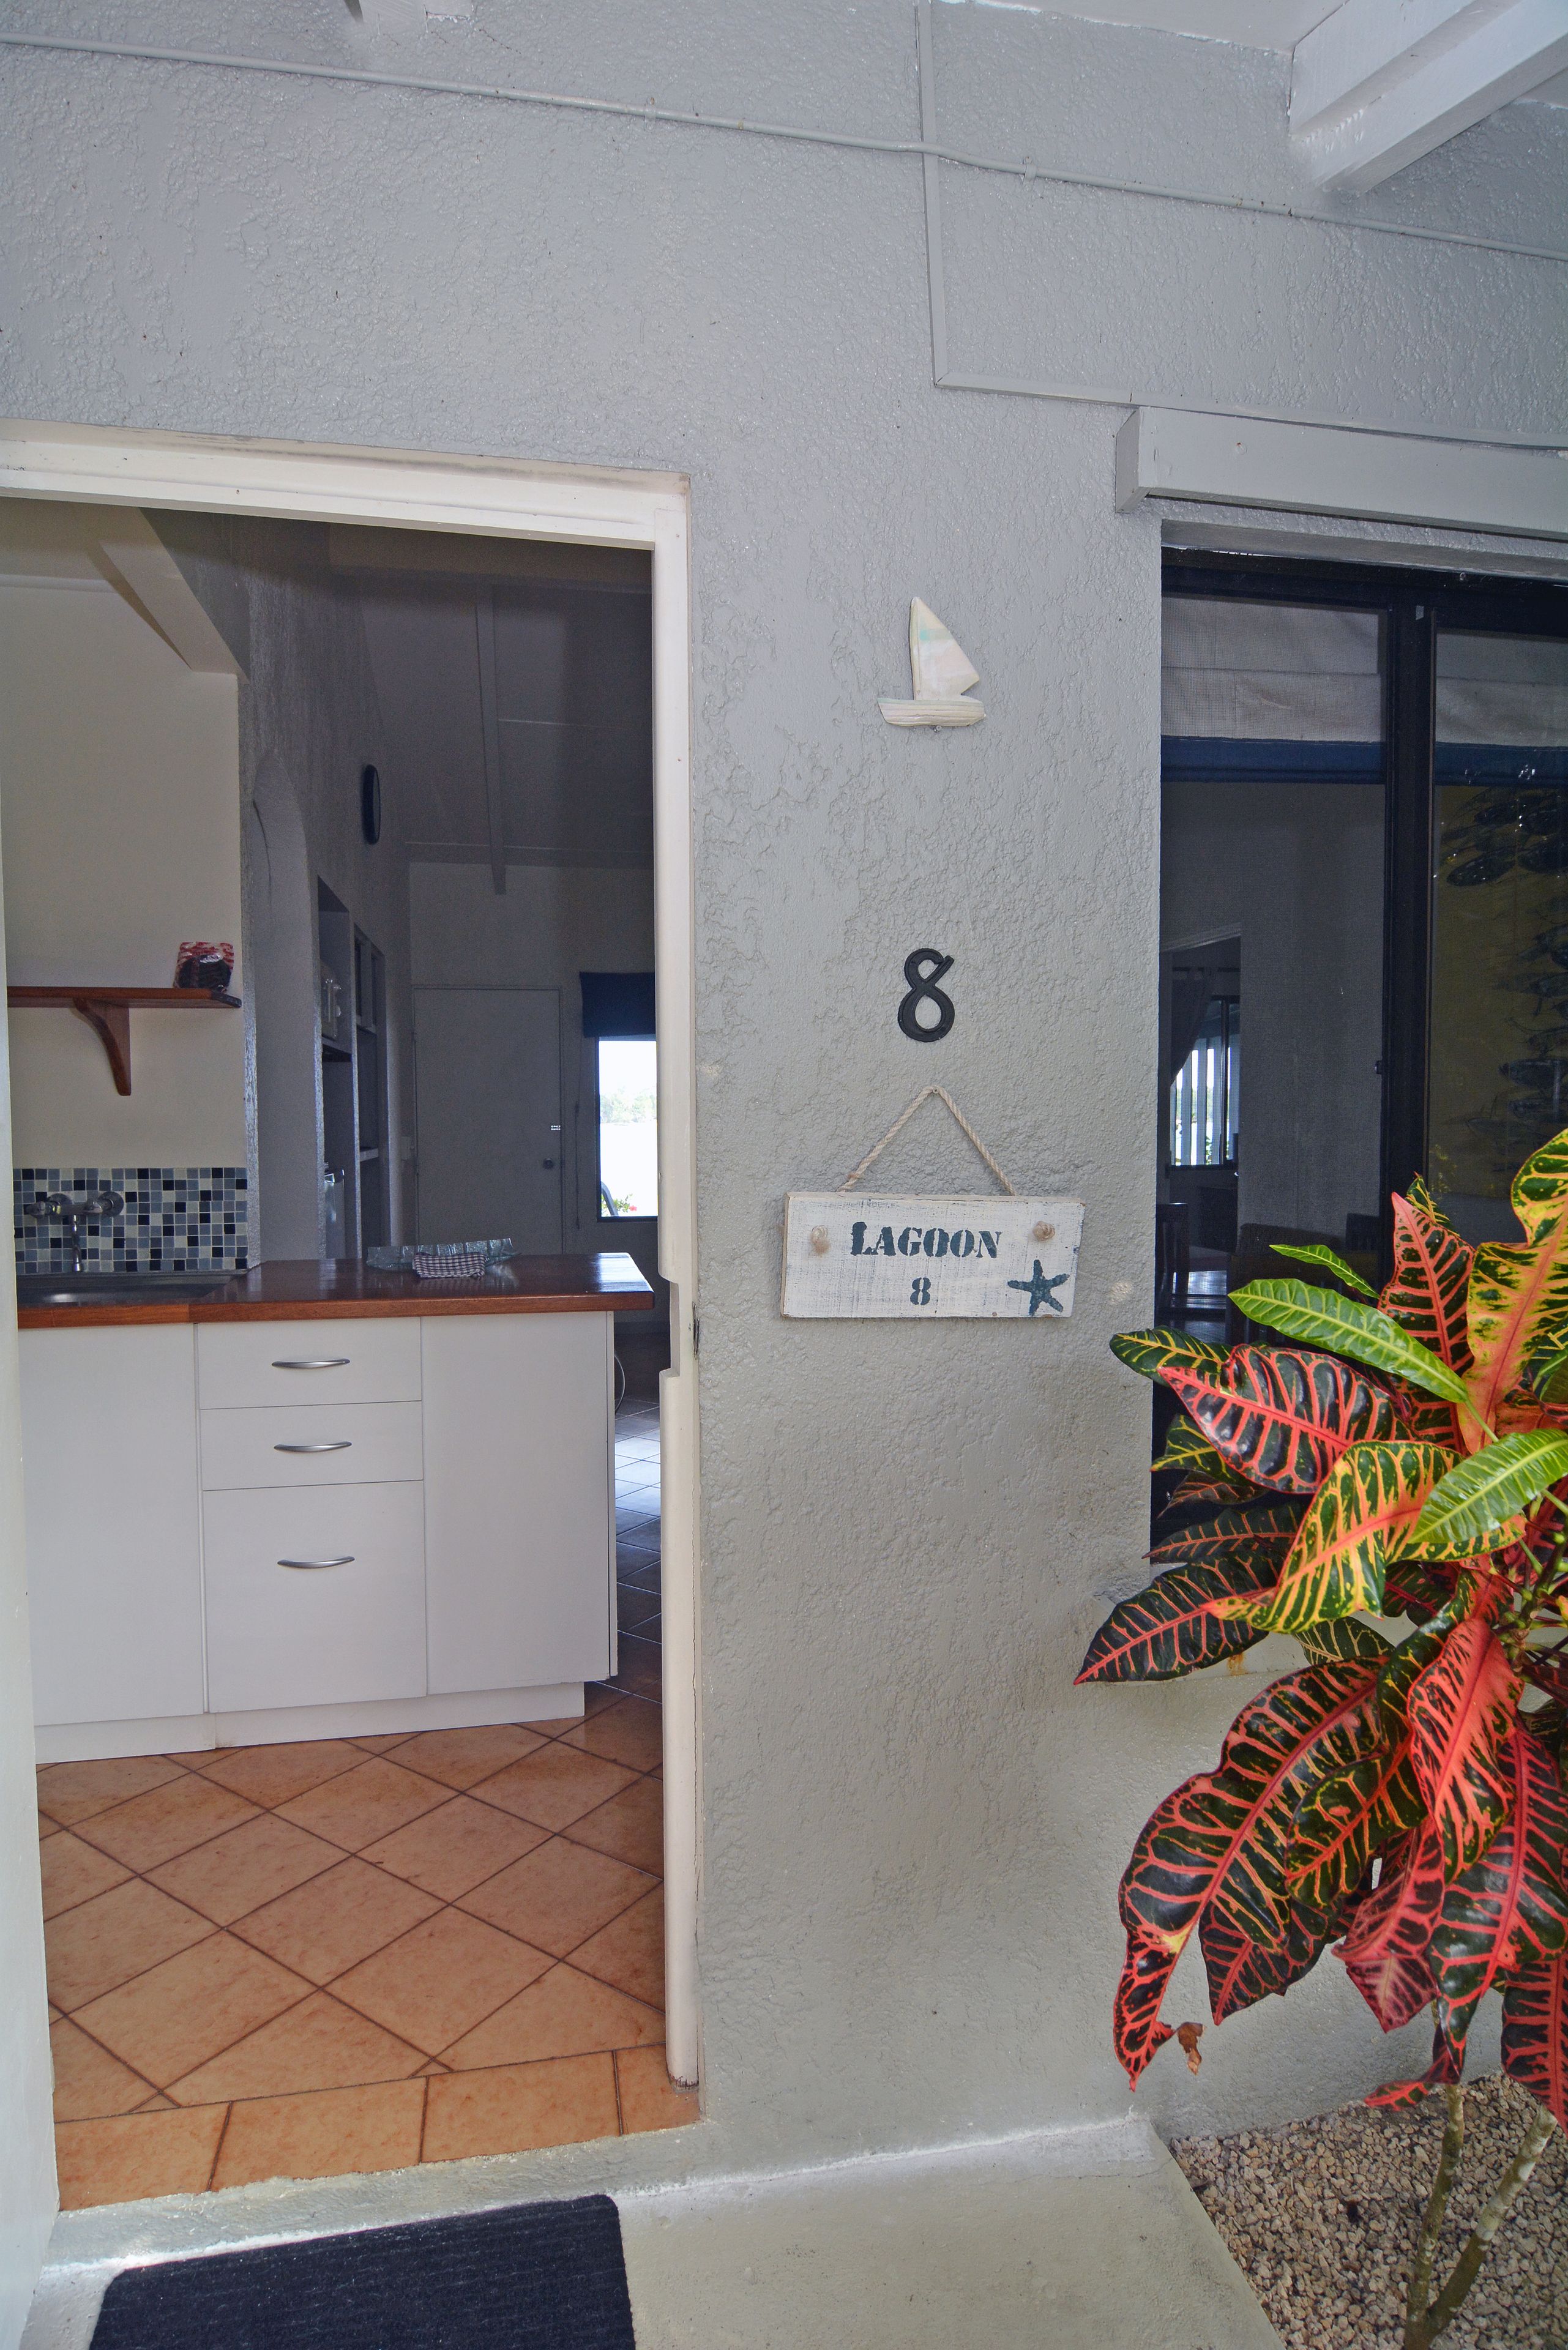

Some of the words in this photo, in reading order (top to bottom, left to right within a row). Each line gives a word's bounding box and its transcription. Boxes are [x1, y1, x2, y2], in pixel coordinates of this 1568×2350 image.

[898, 948, 954, 1042] 8
[850, 1222, 1002, 1258] LAGOON
[909, 1277, 931, 1305] 8
